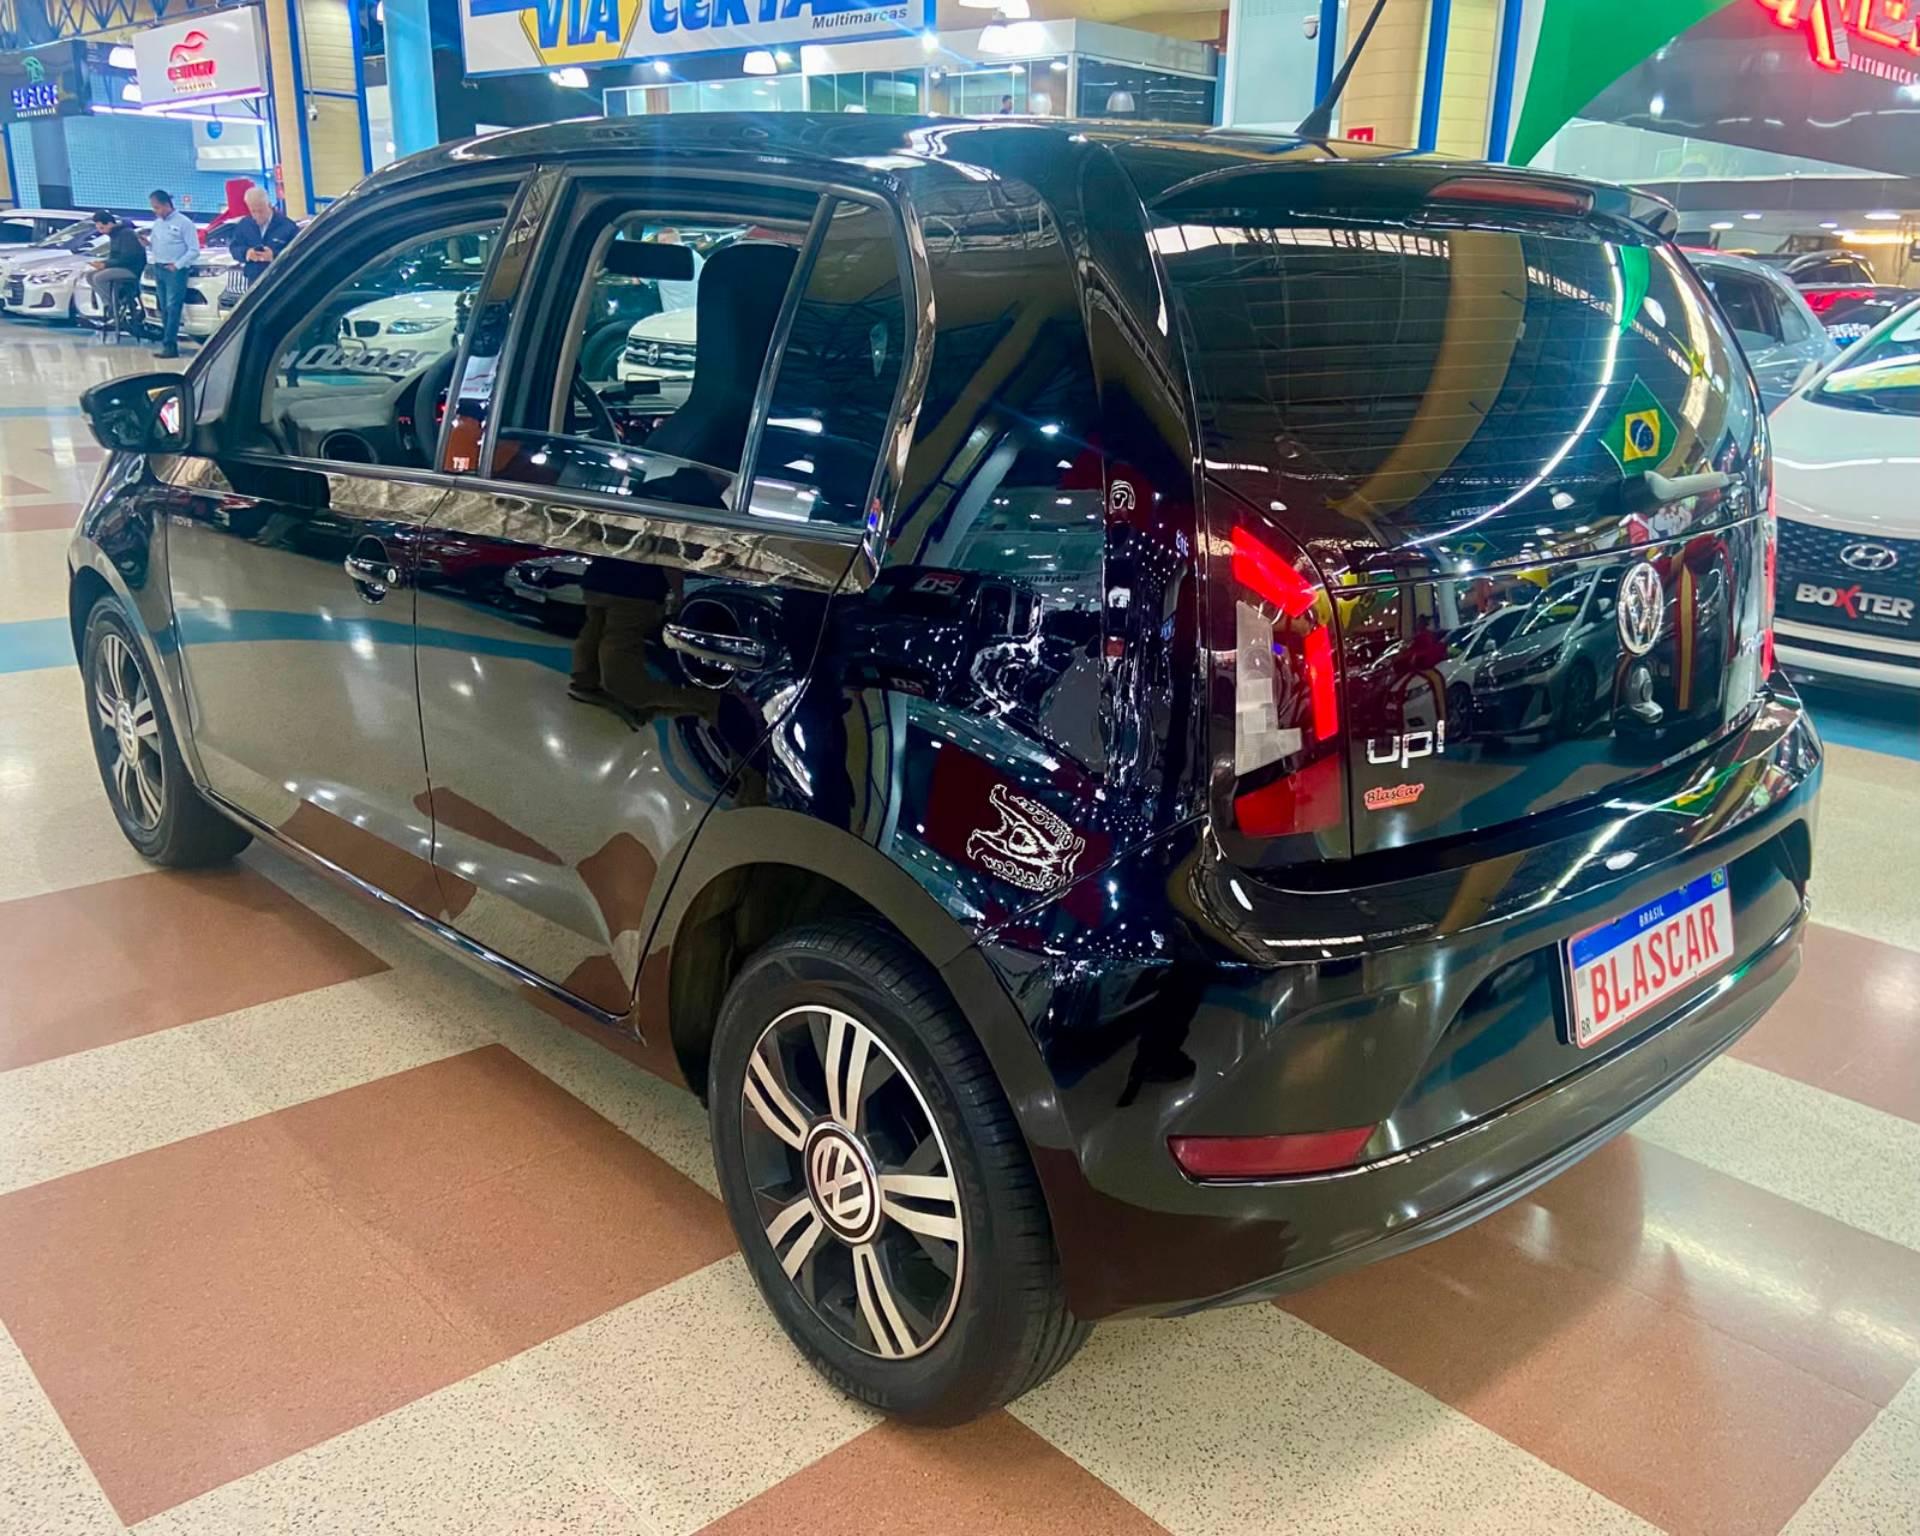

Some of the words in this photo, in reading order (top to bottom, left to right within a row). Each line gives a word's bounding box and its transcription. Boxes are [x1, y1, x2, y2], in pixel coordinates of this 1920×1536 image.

[812, 7, 908, 29] Multimarcas
[1842, 53, 1919, 86] ULTIMARCAS
[1795, 583, 1915, 620] BOXTER
[1367, 719, 1446, 768] up!
[1366, 784, 1424, 805] BlasCar
[1638, 904, 1665, 927] BRASIL
[1590, 902, 1720, 1025] BLASCAR
